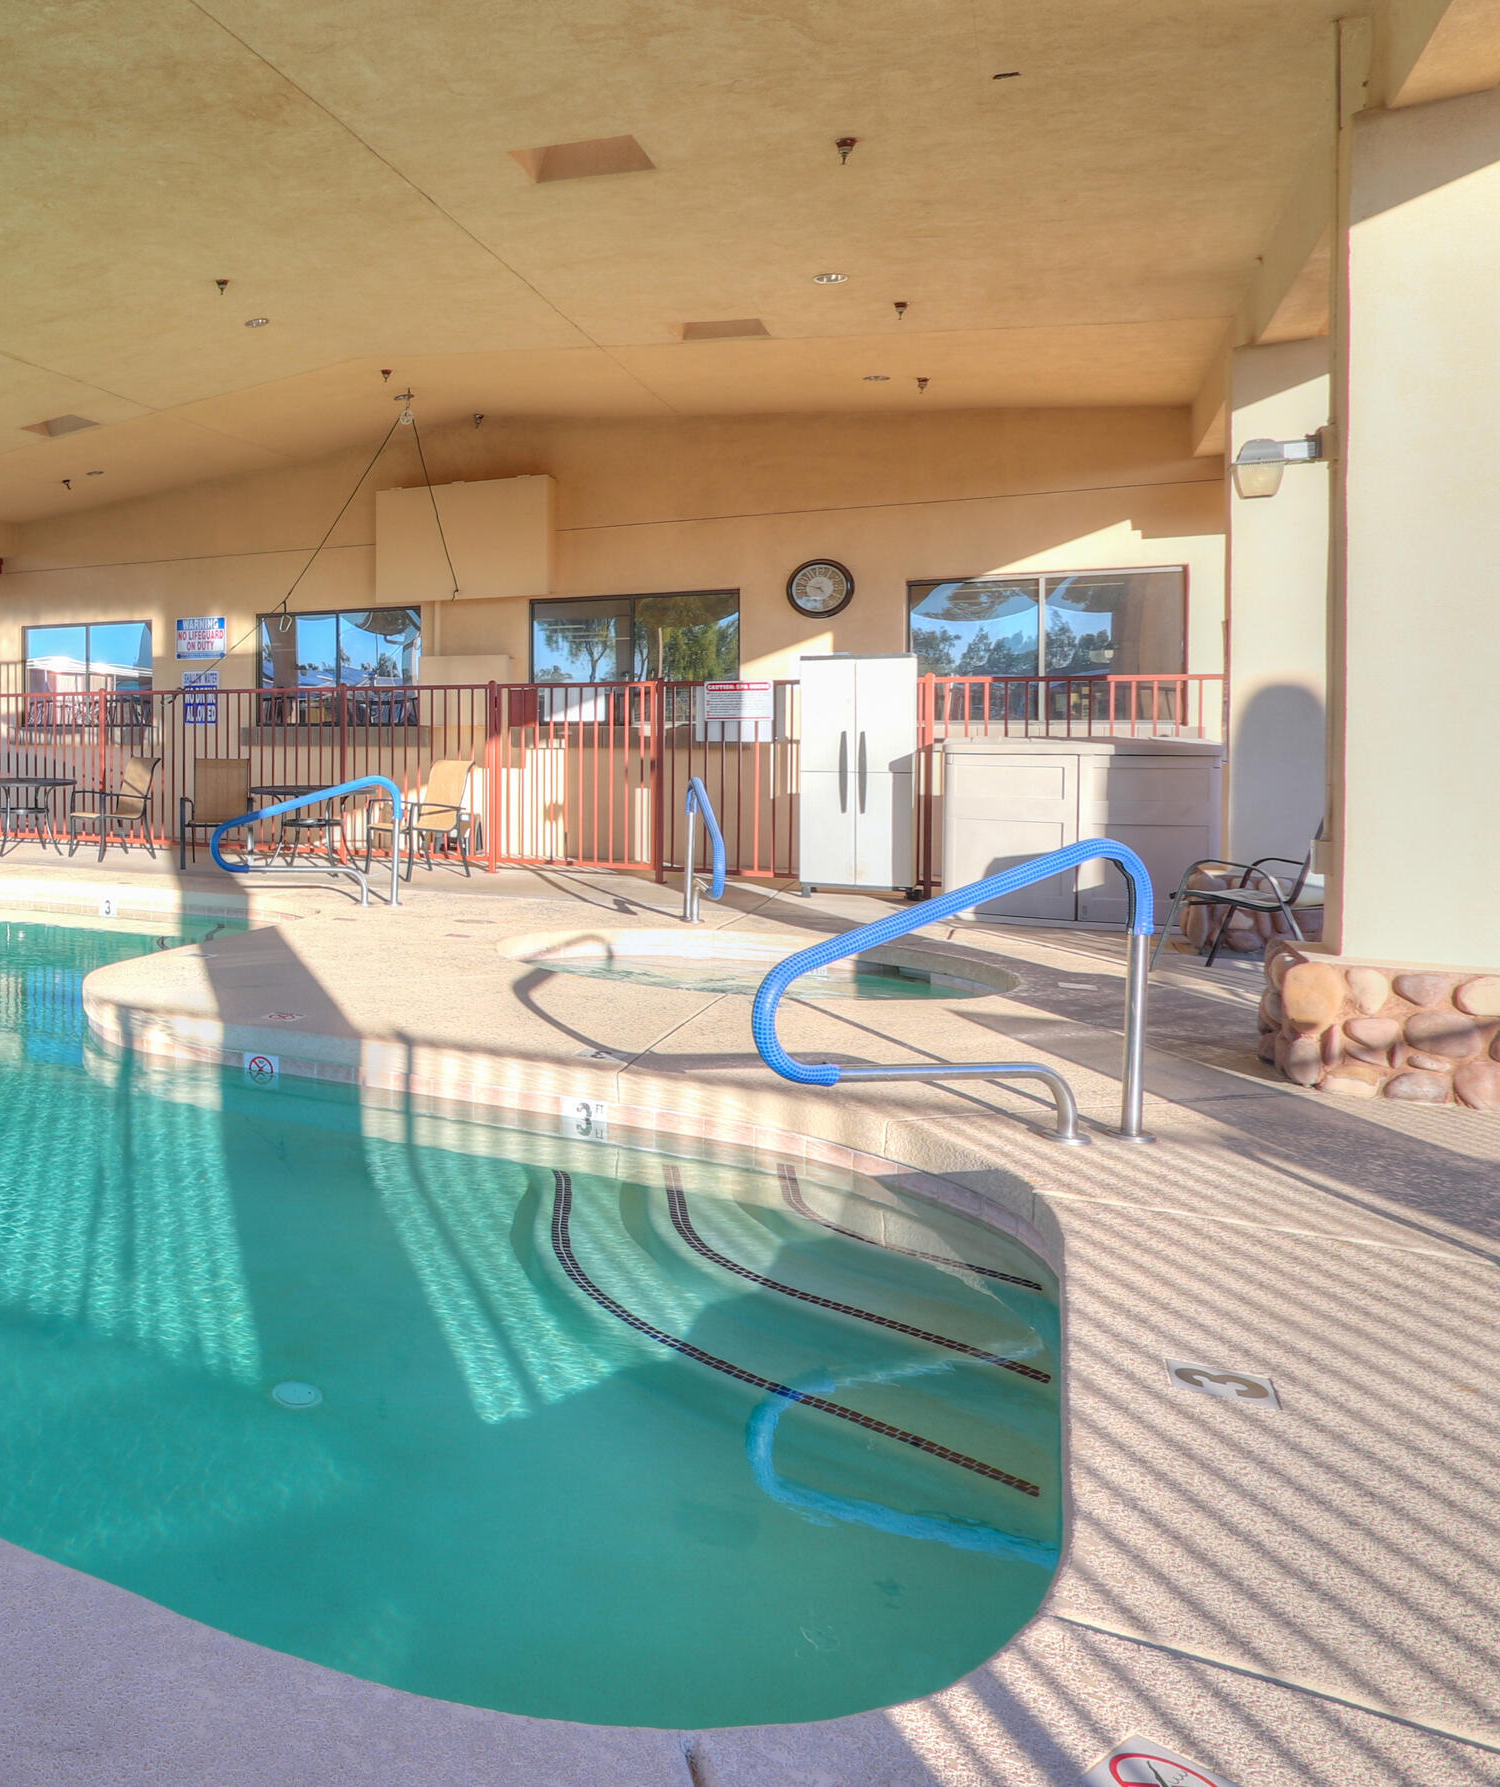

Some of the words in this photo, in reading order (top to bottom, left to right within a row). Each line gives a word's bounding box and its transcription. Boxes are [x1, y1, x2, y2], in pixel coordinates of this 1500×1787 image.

[183, 618, 219, 630] WARNING
[178, 631, 188, 641] NO
[189, 630, 224, 640] LIFEGUARD
[187, 641, 197, 651] ON
[198, 641, 215, 650] DUTY
[1174, 1367, 1269, 1399] 3
